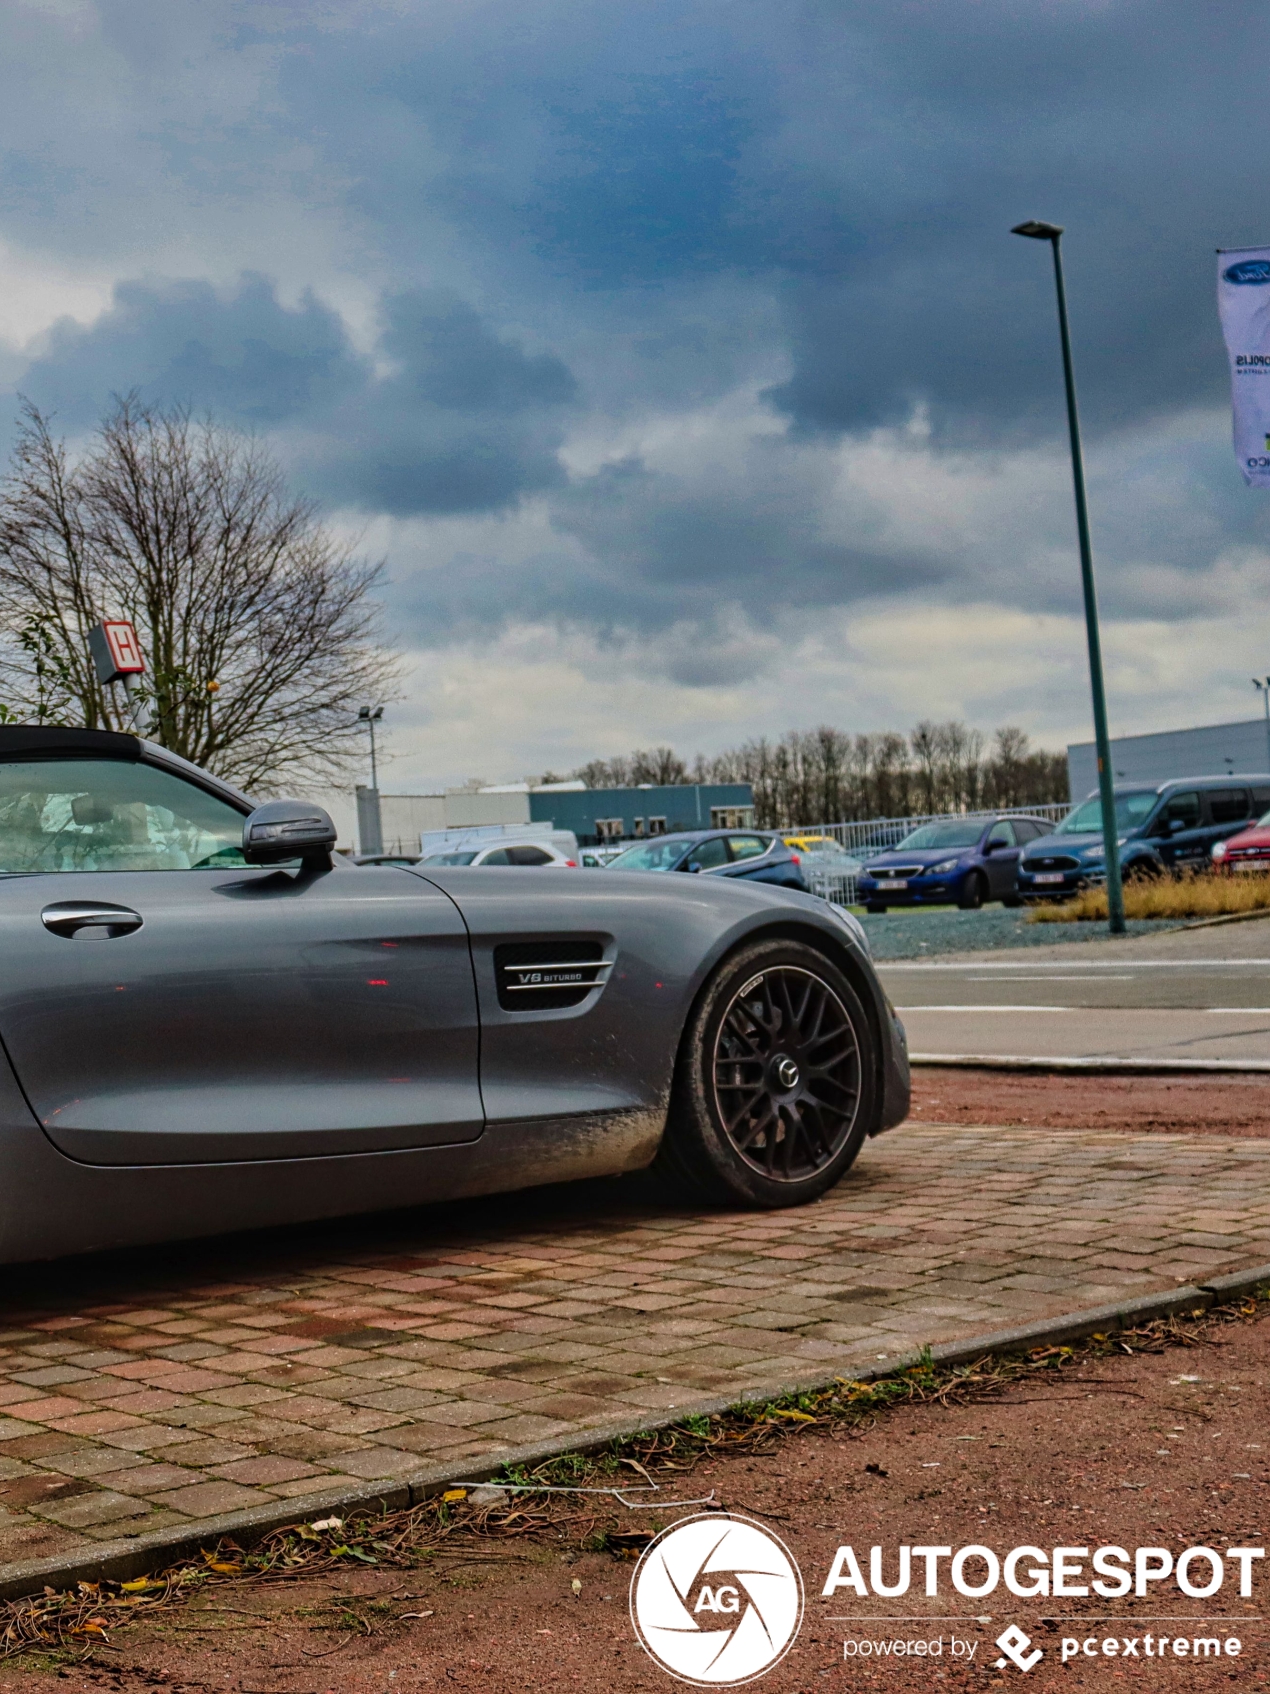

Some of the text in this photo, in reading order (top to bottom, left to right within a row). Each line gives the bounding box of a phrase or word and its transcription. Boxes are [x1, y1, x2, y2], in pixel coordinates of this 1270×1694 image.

[113, 631, 136, 662] H
[518, 973, 582, 983] V8 BITURBO
